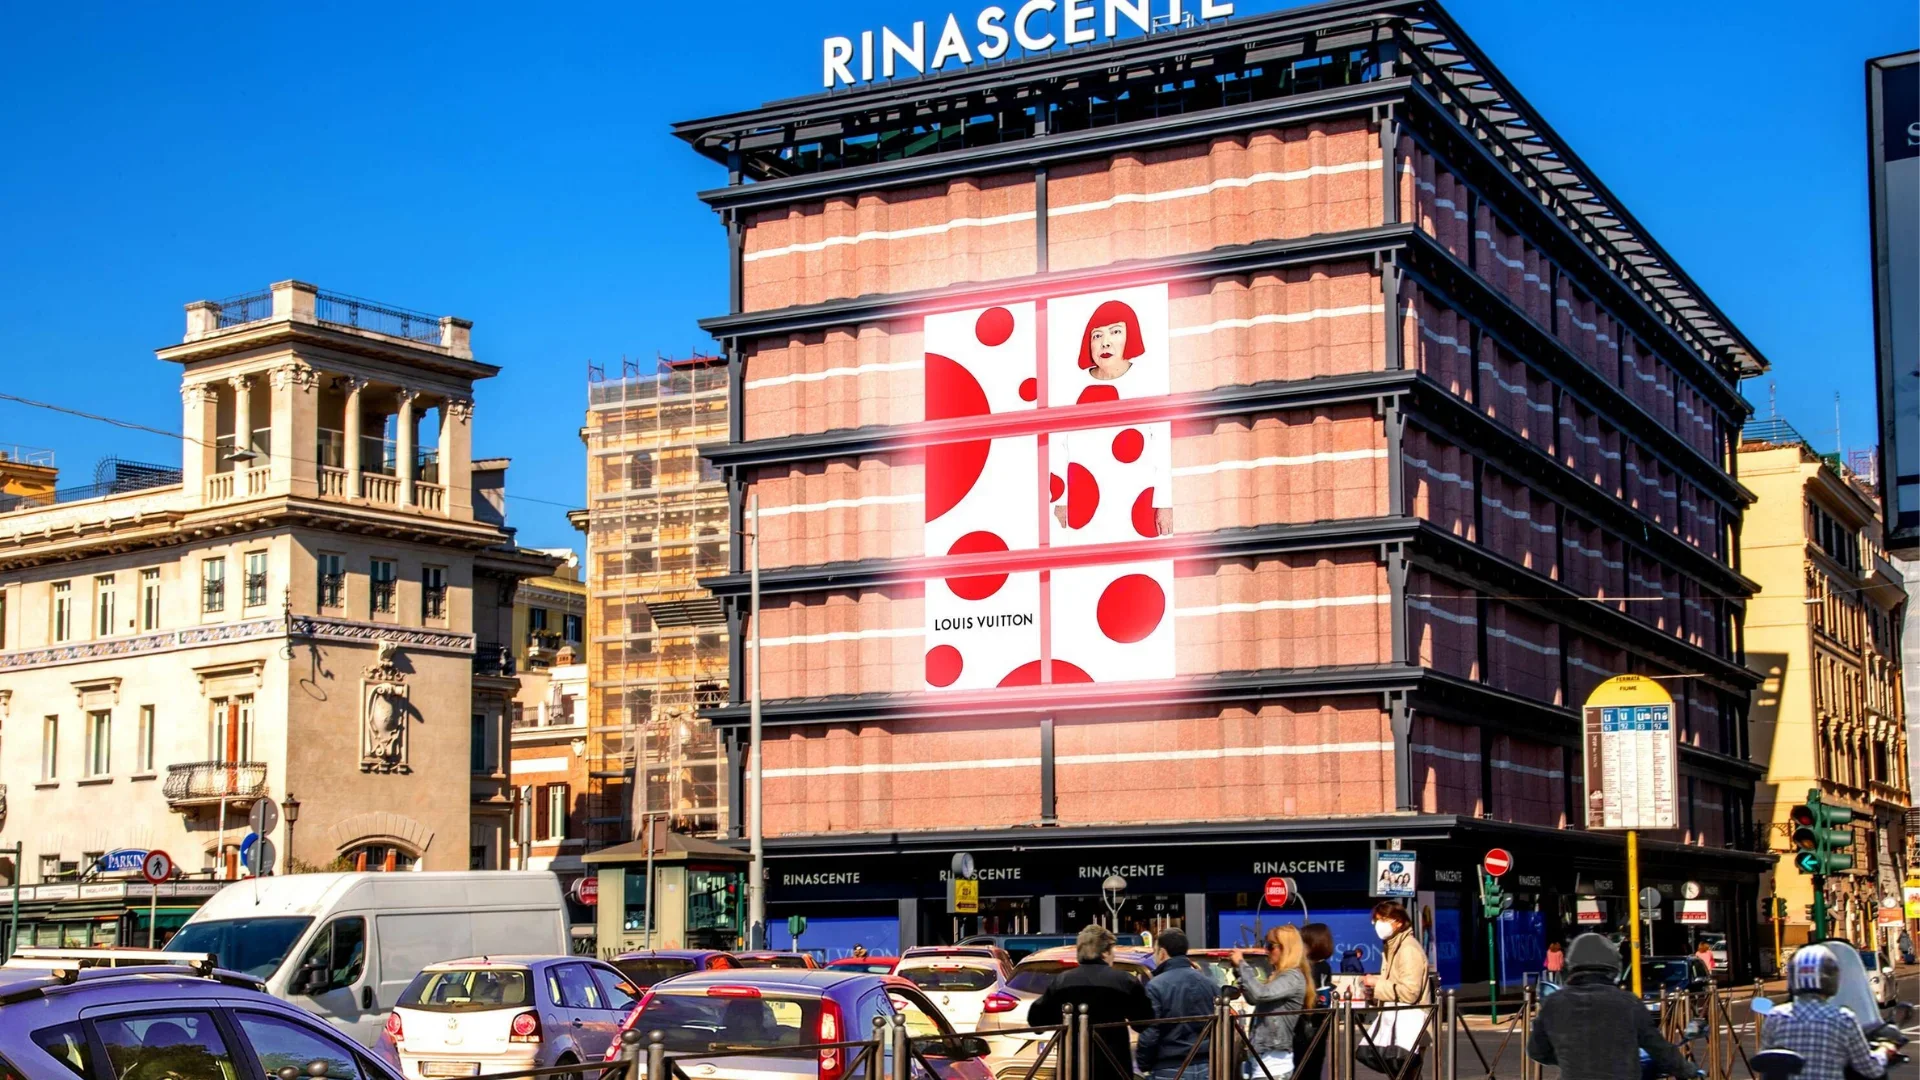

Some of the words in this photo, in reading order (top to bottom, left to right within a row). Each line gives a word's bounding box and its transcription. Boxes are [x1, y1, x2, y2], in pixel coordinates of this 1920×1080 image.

[934, 616, 974, 632] LOUIS
[976, 612, 1034, 629] VUITTON
[108, 854, 146, 869] PARKIN
[1253, 860, 1345, 874] RINASCENTE
[939, 867, 1021, 881] RISCENTE
[1078, 864, 1165, 878] RINASCENTE
[783, 872, 861, 885] RINASCENTE
